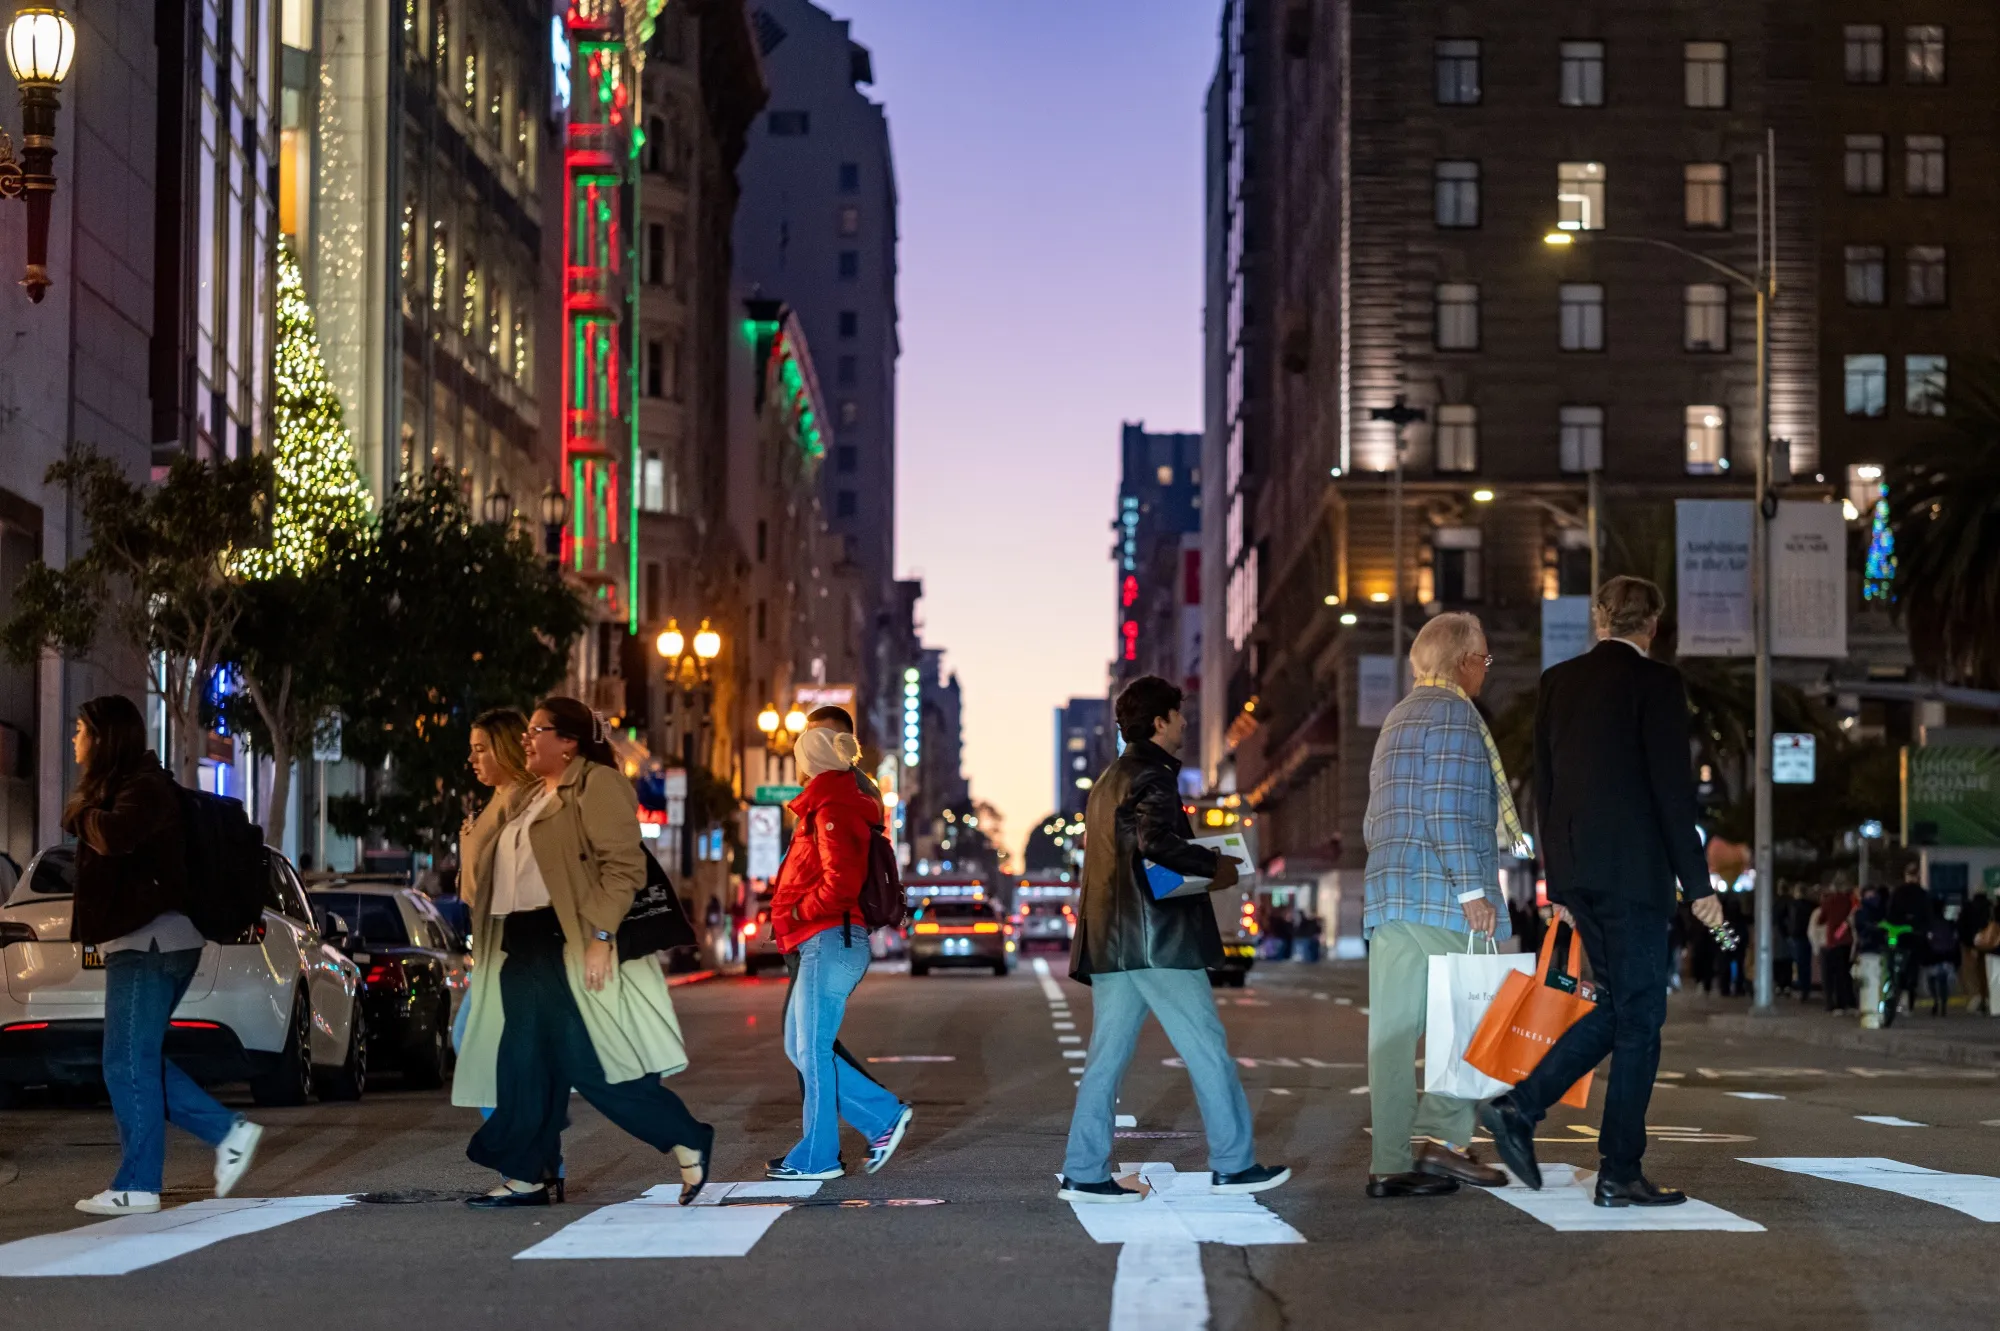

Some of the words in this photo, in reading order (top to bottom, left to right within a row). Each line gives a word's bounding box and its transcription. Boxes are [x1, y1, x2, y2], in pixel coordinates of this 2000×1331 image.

[1912, 759, 1976, 774] UNION
[1468, 991, 1480, 1000] Just
[1545, 1036, 1557, 1046] BA
